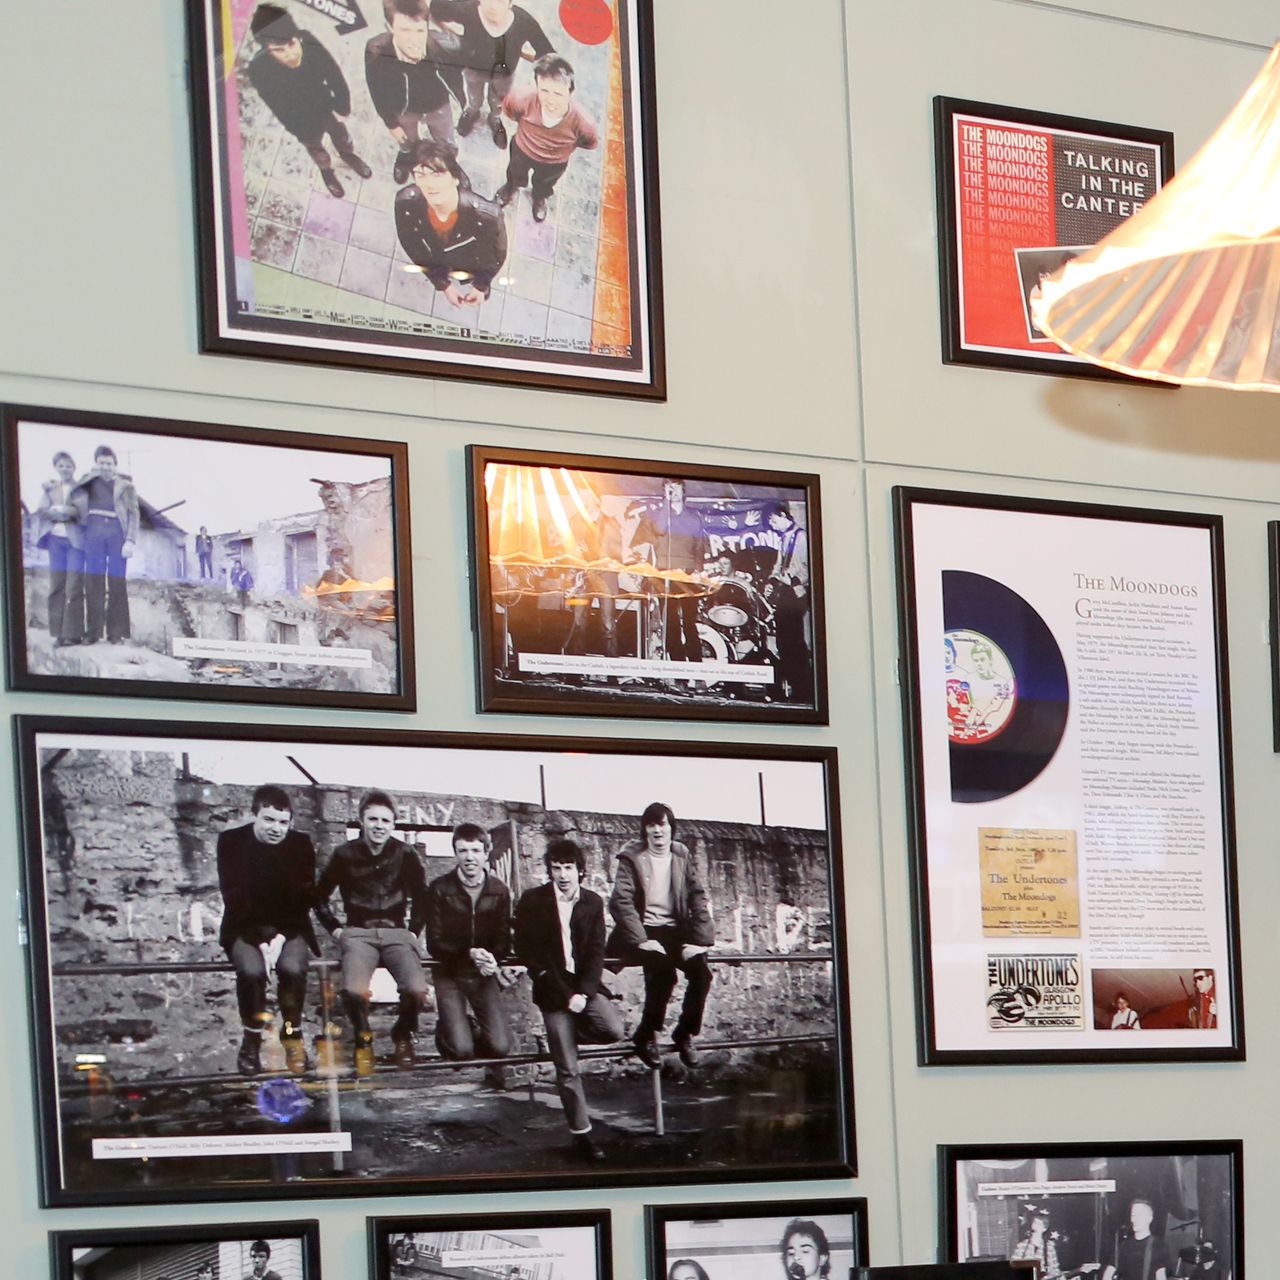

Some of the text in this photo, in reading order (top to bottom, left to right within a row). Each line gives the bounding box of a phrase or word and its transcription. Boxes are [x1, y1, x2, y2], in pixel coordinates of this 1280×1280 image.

[304, 0, 356, 25] ONES
[962, 125, 1047, 151] THE MOONDOGS
[963, 141, 1048, 167] THE MOONDOGS
[1064, 150, 1149, 178] TALKING
[963, 157, 1048, 182] THE MOONDOGS
[964, 172, 1049, 197] THE MOONDOGS
[1081, 174, 1145, 198] IN THE
[964, 188, 1049, 212] THE MOONDOGS
[1061, 193, 1144, 217] CANTEE
[965, 203, 1049, 227] THE MOONDOGS
[1073, 572, 1198, 598] THE MOONDOGS
[989, 873, 1068, 885] The Undertones
[1002, 892, 1056, 902] The Moondogs
[988, 958, 1079, 987] THE UNDERTONES
[1042, 994, 1080, 1005] APOLLO
[1043, 986, 1076, 994] GLASGOW
